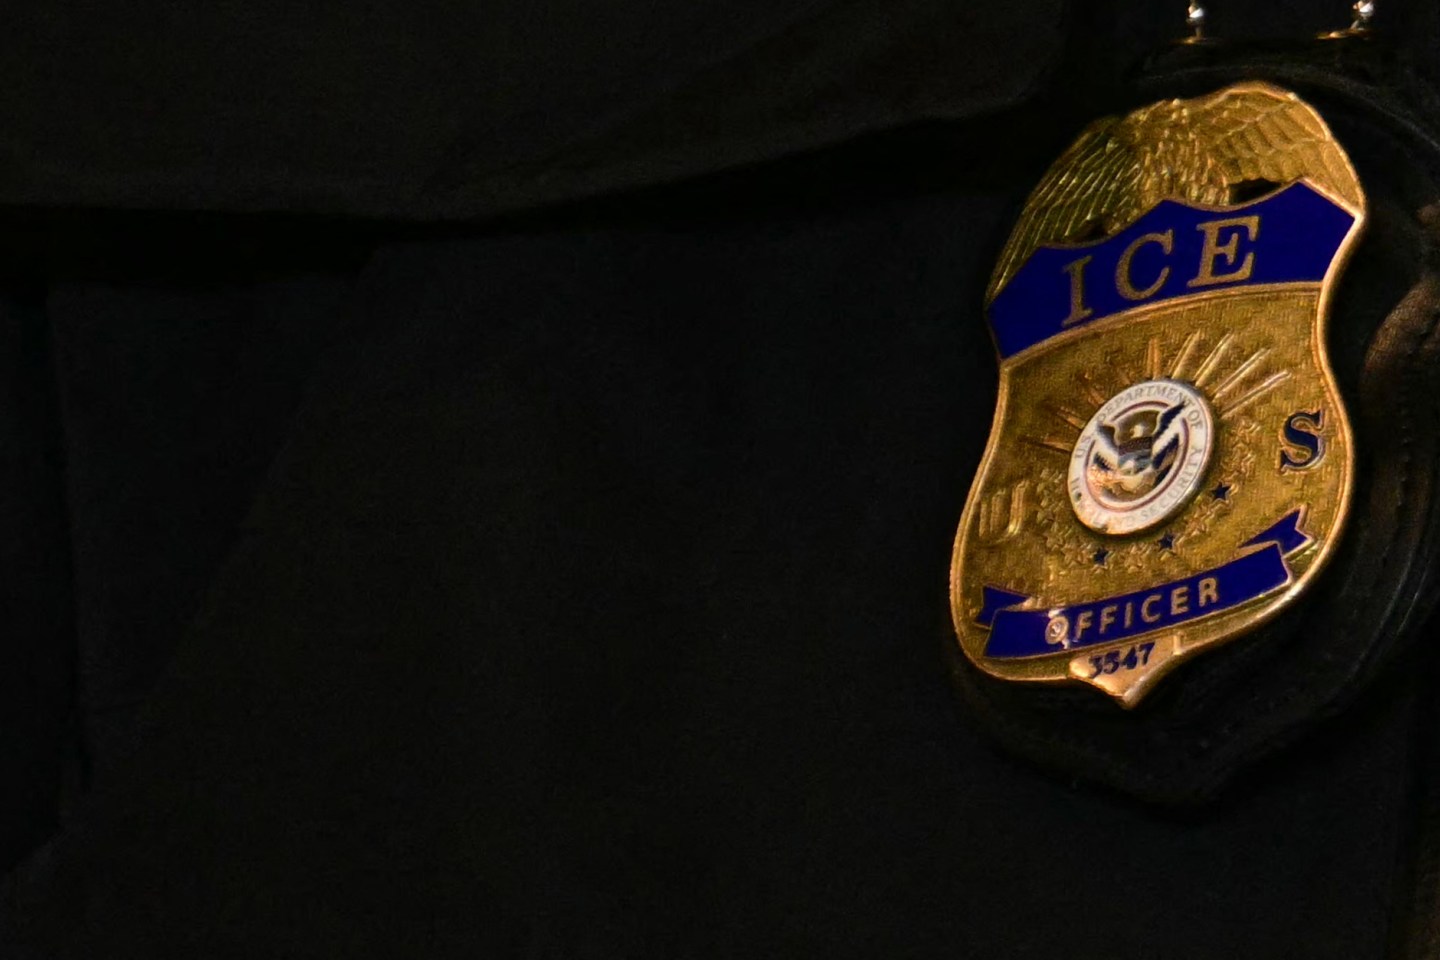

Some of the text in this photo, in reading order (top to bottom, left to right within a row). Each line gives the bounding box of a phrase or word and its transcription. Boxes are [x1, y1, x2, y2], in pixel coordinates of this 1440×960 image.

[1061, 214, 1261, 328] ICE
[1279, 410, 1326, 474] S
[1044, 576, 1219, 645] OFFICER
